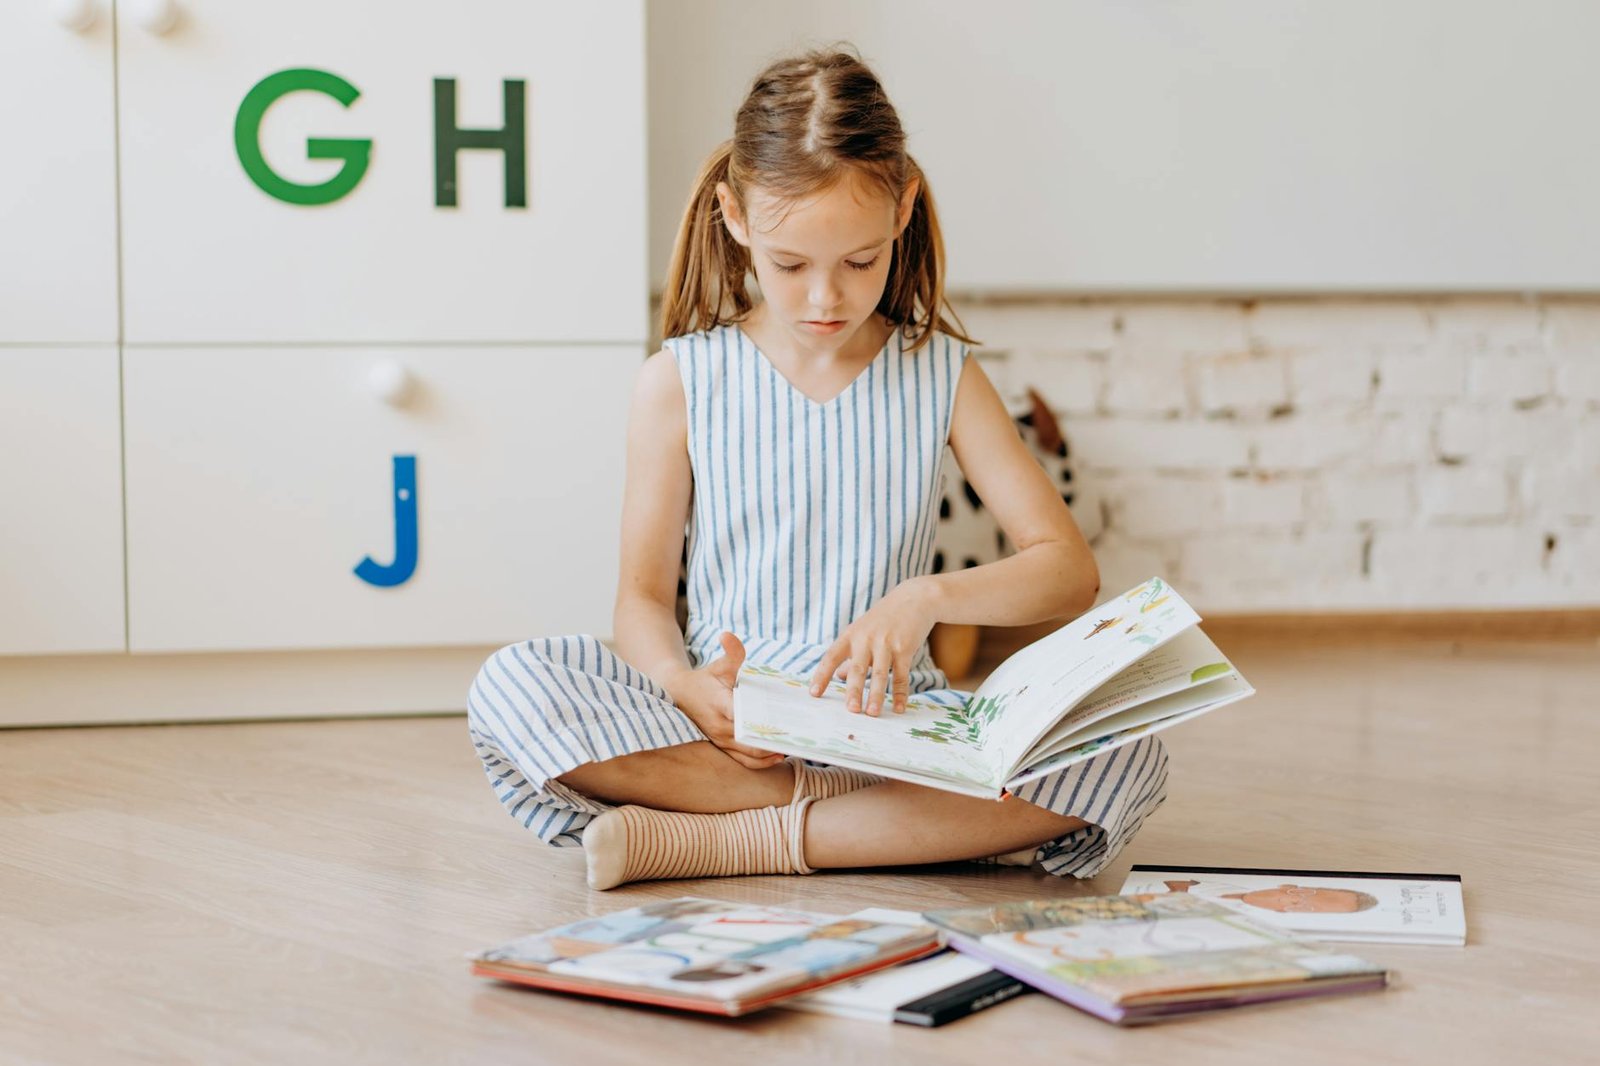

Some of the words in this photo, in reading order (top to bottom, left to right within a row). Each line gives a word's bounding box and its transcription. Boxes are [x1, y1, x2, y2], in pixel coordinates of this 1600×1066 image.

[234, 68, 373, 206] G
[433, 77, 528, 209] H
[353, 455, 419, 588] J
